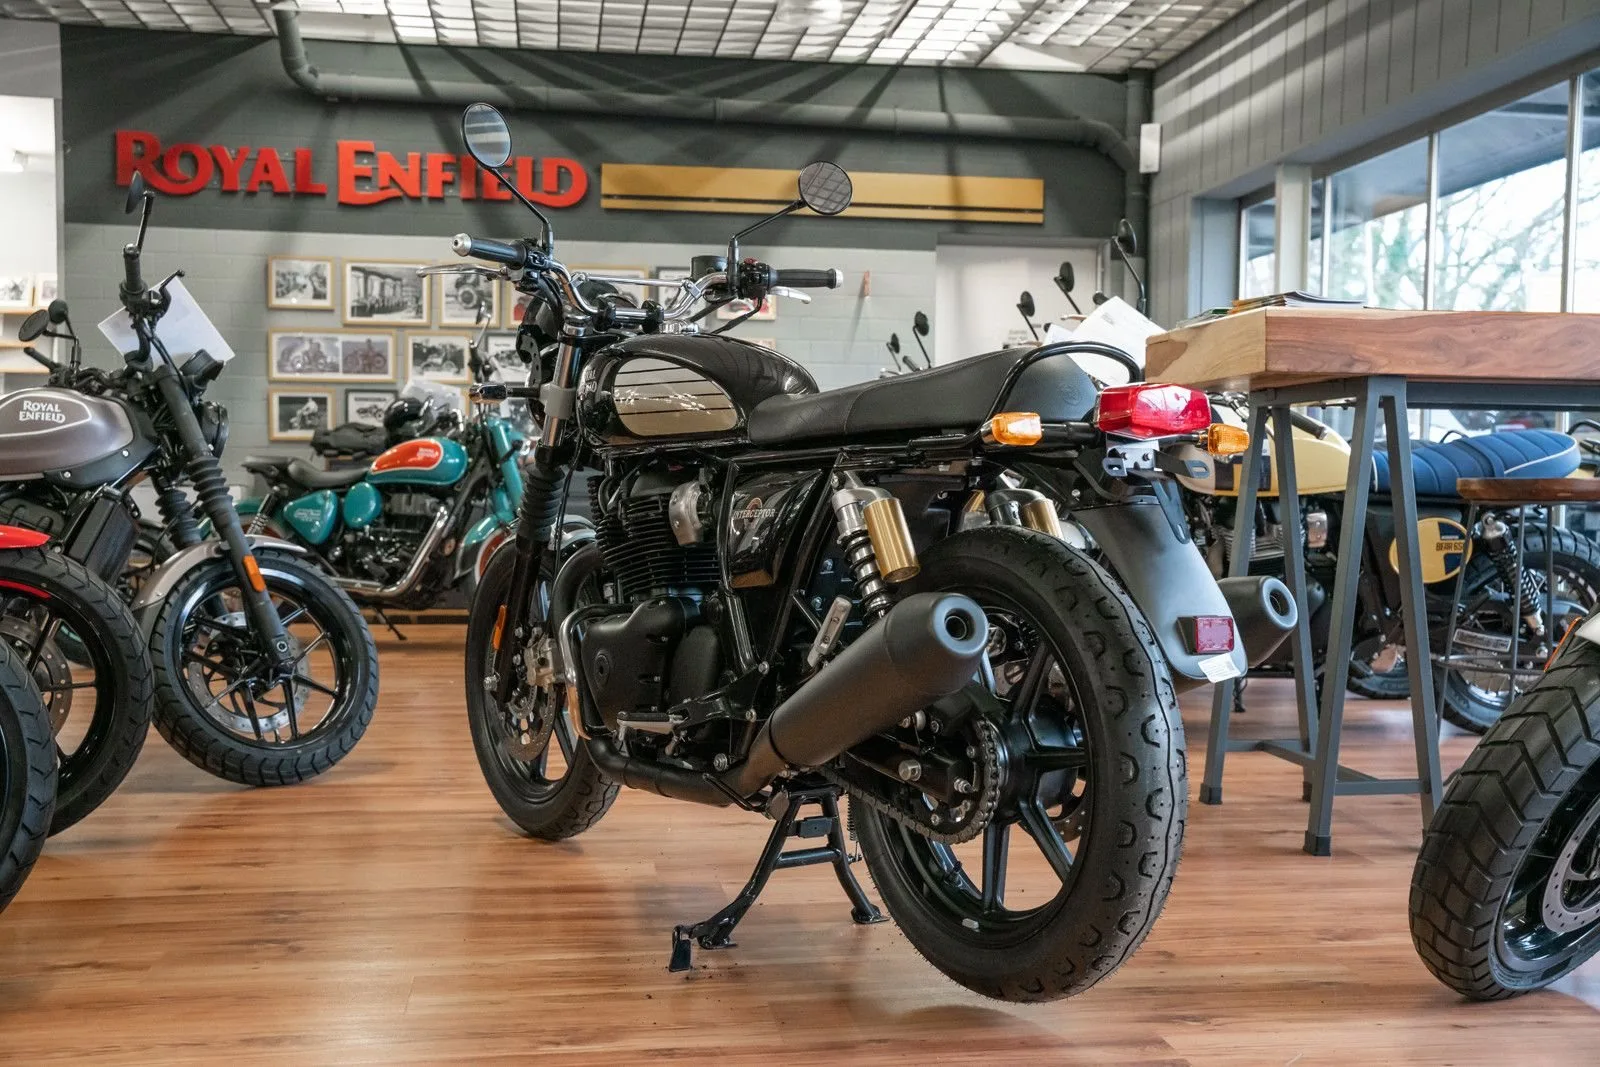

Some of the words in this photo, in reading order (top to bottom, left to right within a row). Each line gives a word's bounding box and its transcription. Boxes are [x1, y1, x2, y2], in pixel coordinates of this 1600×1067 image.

[115, 129, 327, 195] ROYAL
[337, 140, 588, 207] ENFIELD
[23, 400, 61, 412] ROYAL
[19, 410, 66, 424] ENFIELD
[733, 509, 775, 518] INTERCEPTOR
